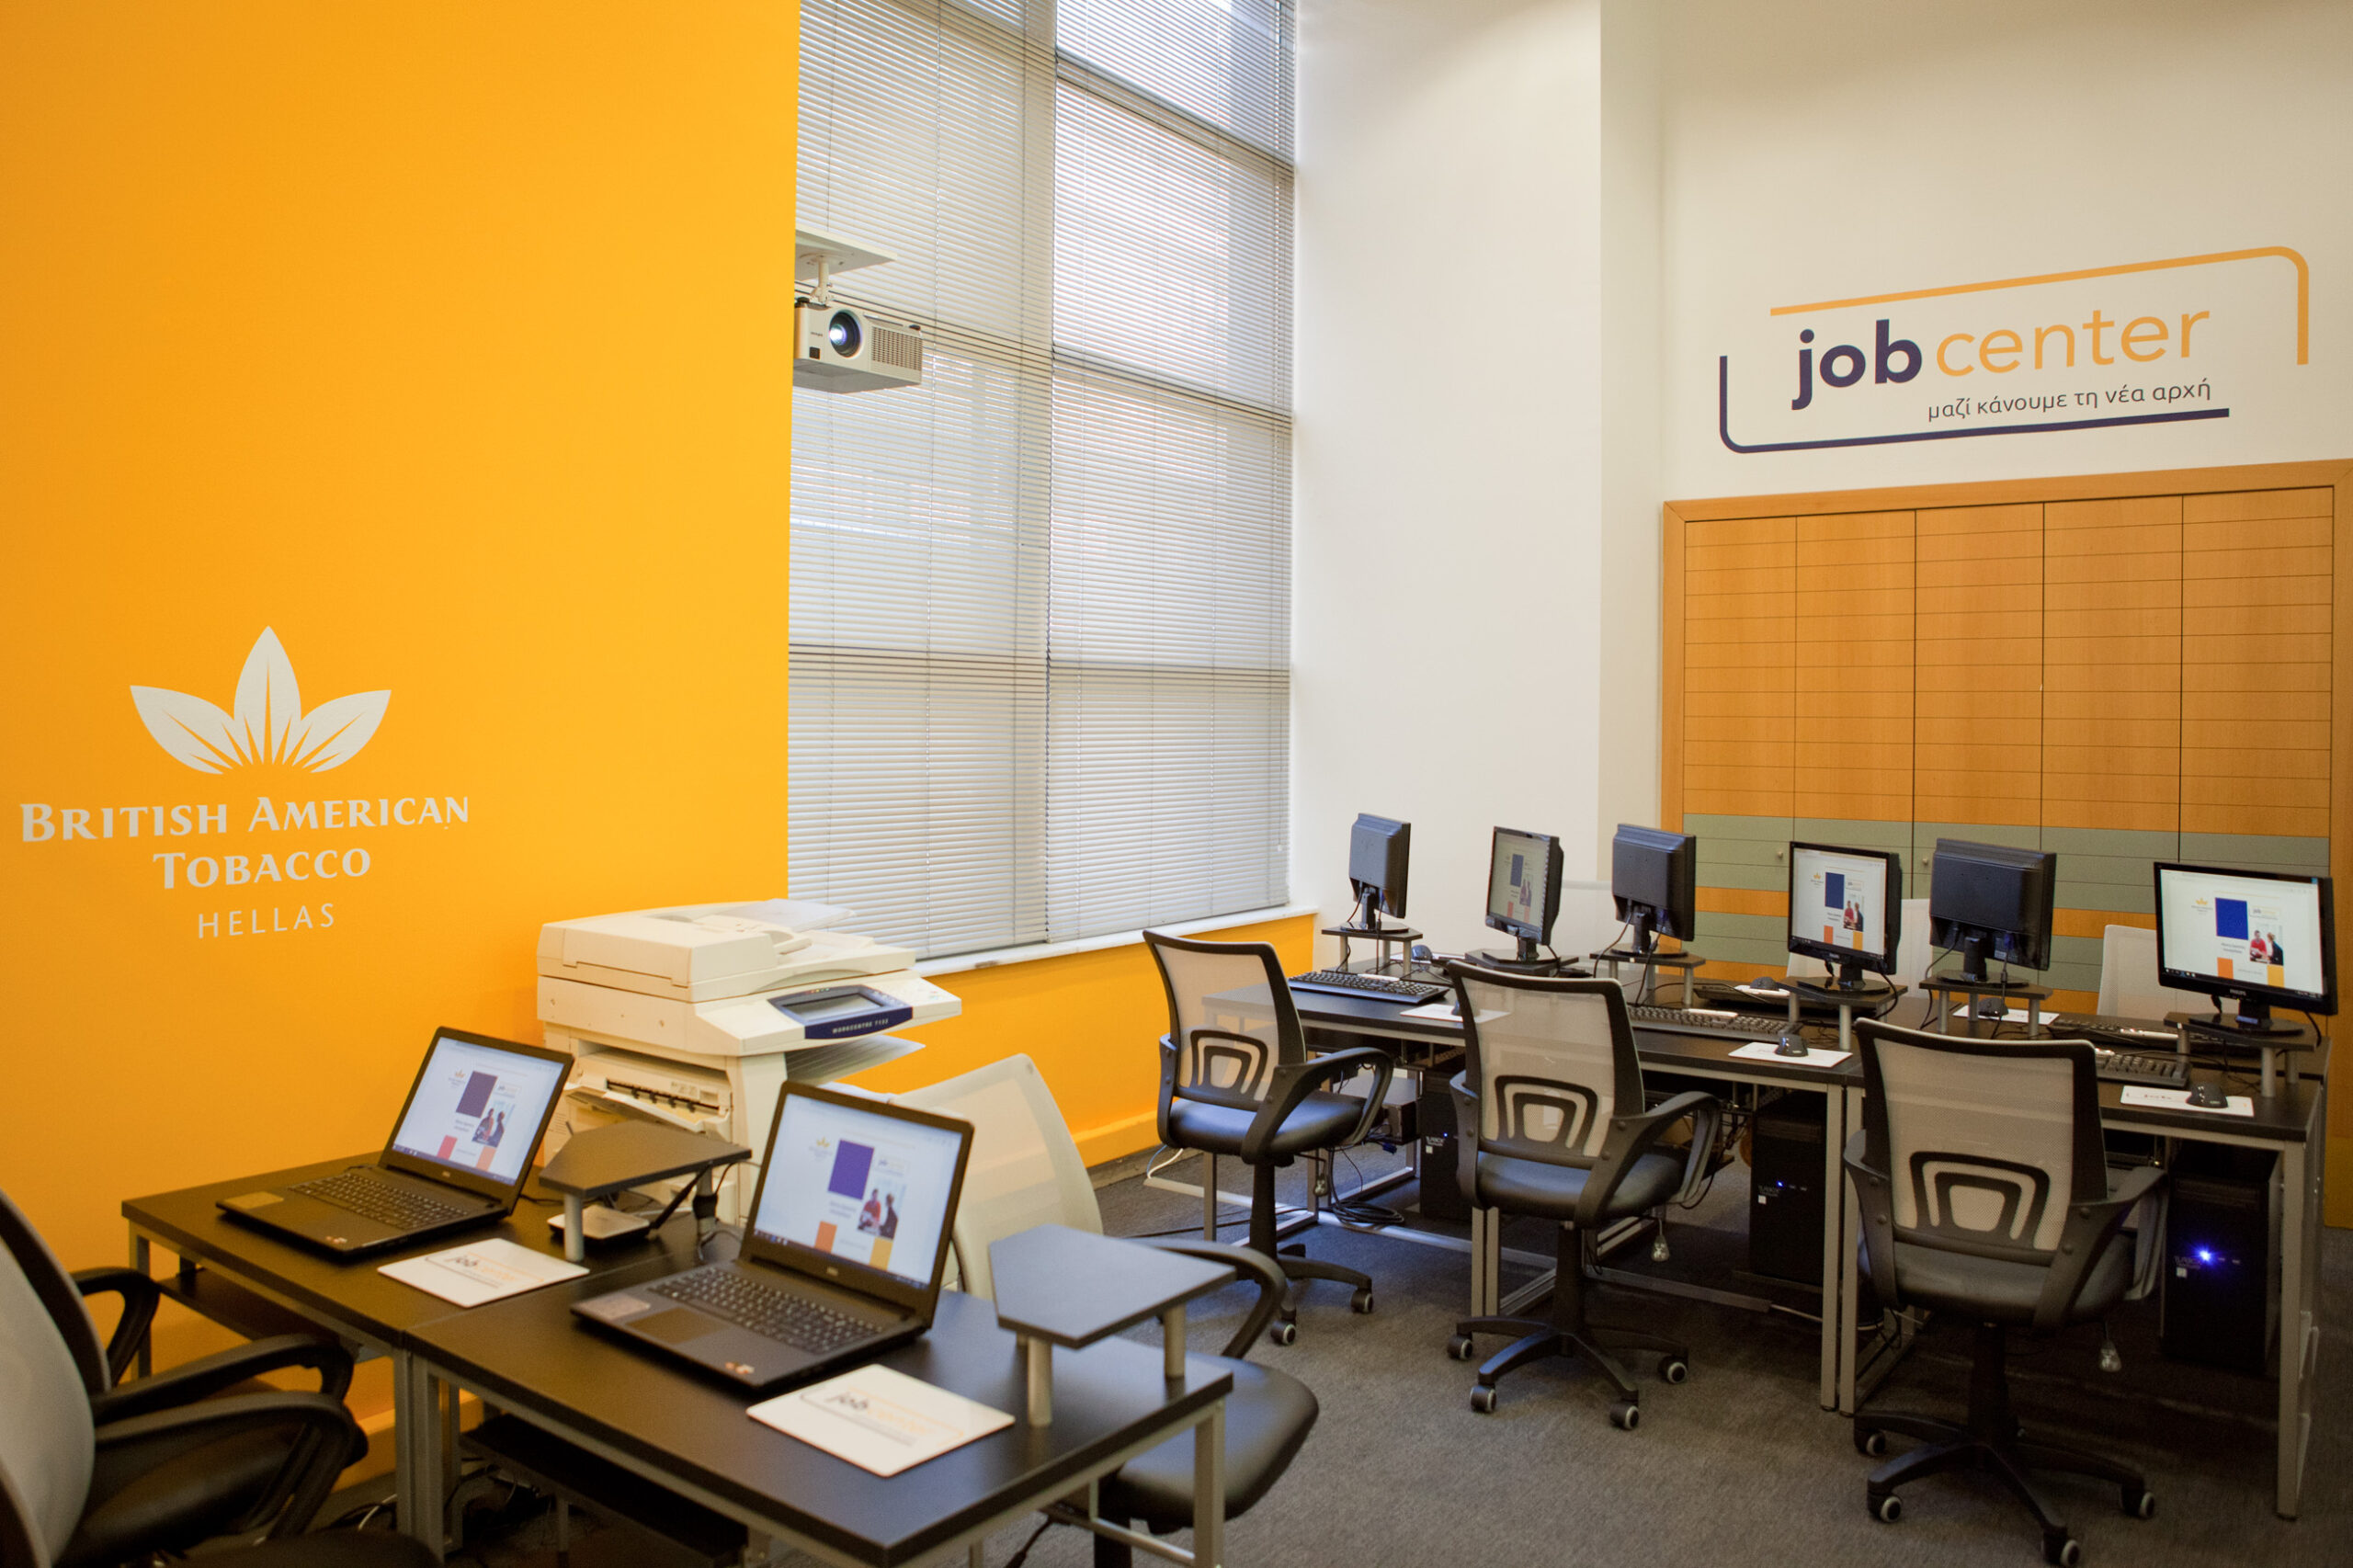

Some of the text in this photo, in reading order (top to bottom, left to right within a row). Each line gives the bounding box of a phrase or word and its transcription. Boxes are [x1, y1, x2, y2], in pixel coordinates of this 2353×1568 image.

[1928, 378, 2211, 422] μαζί κάνουμε τη νέα αρχή
[19, 796, 470, 843] BRITISH AMERICAN
[153, 847, 371, 890] TOBACCO
[198, 903, 335, 939] HELLAS
